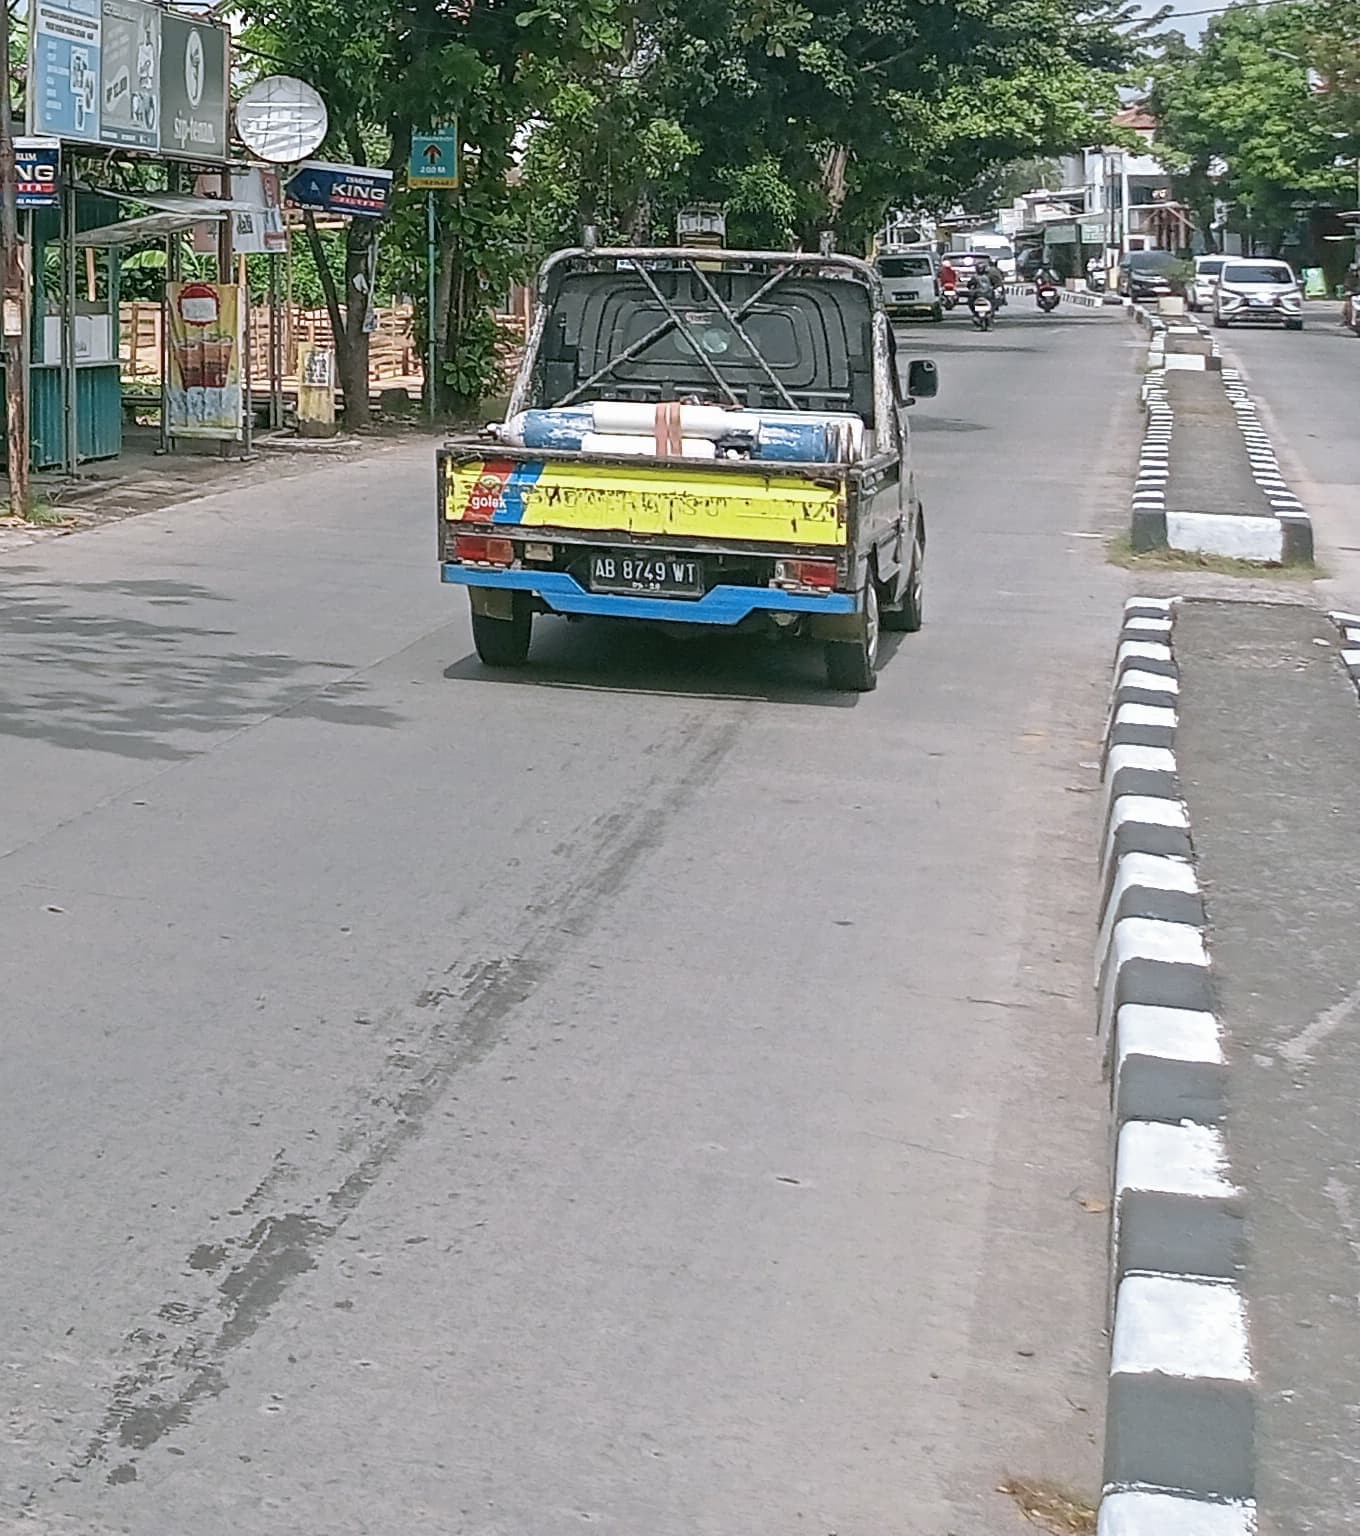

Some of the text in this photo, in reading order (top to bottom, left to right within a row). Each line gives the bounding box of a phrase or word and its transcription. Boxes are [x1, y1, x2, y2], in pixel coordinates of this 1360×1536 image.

[332, 183, 386, 200] KING
[595, 558, 696, 583] AB 8749 WT
